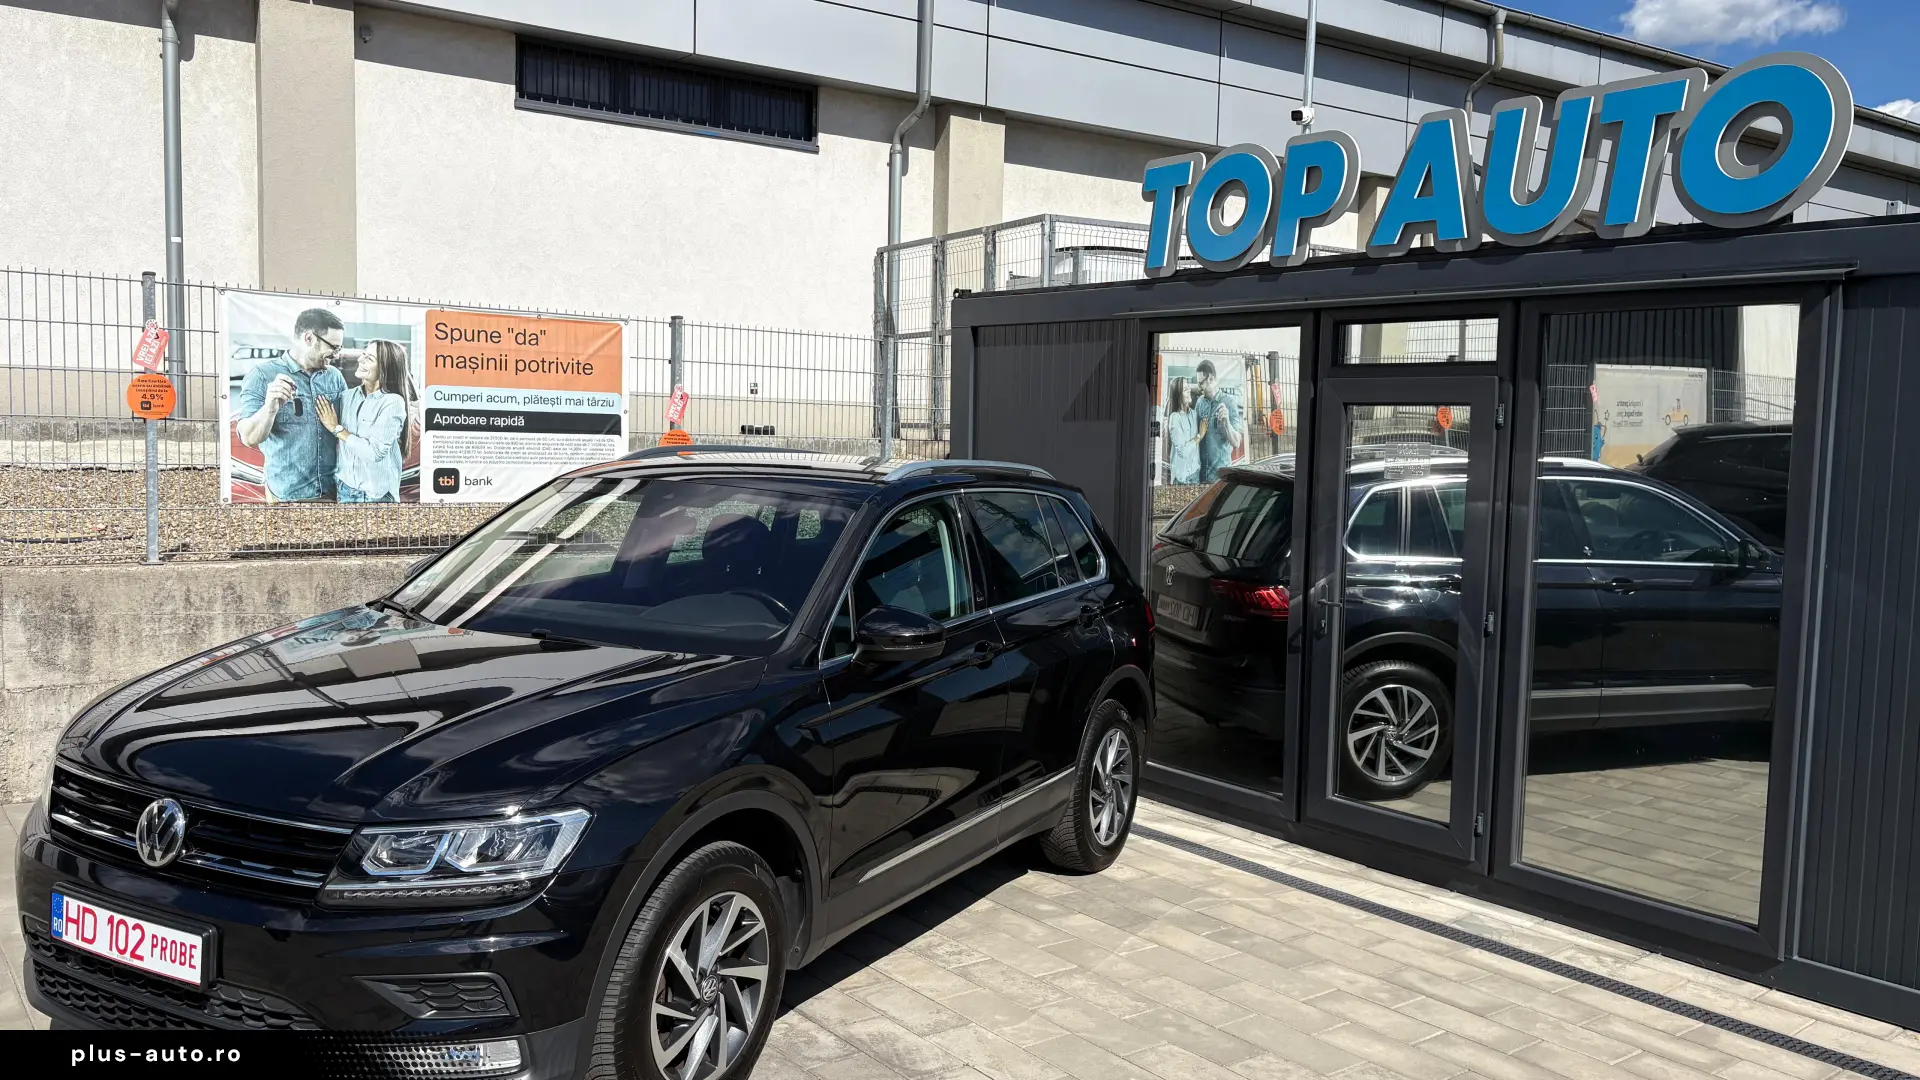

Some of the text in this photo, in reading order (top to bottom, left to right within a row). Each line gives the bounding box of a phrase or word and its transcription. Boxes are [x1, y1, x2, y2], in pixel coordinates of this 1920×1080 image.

[1142, 54, 1852, 277] TOP AUTO
[434, 322, 546, 346] Spune "da"
[434, 352, 594, 376] mașinii potrivite
[434, 390, 615, 408] Cumperi acum, plătești mai târziu
[433, 413, 525, 428] Aprobare rapidă
[438, 476, 493, 486] tbi bank
[54, 917, 63, 932] RO
[64, 900, 198, 970] HD 102 PROBE
